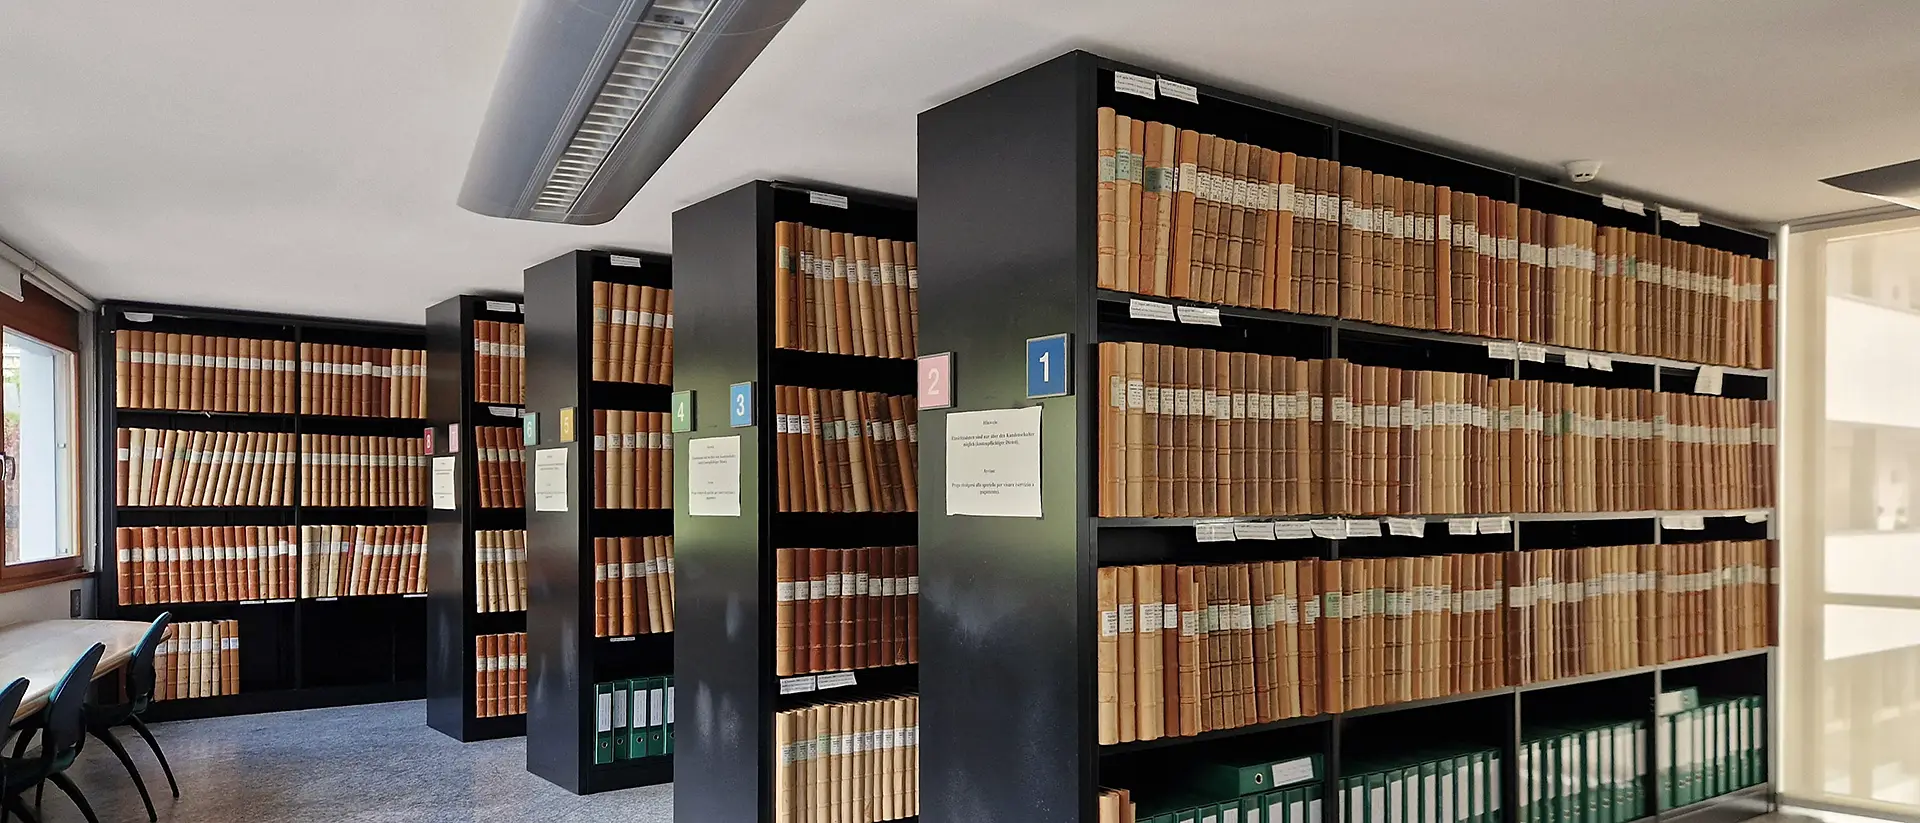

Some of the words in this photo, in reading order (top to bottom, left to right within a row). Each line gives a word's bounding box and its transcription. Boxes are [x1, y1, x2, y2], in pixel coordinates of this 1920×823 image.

[1038, 351, 1049, 382] 1
[928, 368, 940, 396] 2
[677, 402, 684, 422] 4
[736, 394, 745, 416] 3
[526, 420, 532, 438] 6
[564, 416, 570, 434] 5
[426, 434, 431, 448] 8
